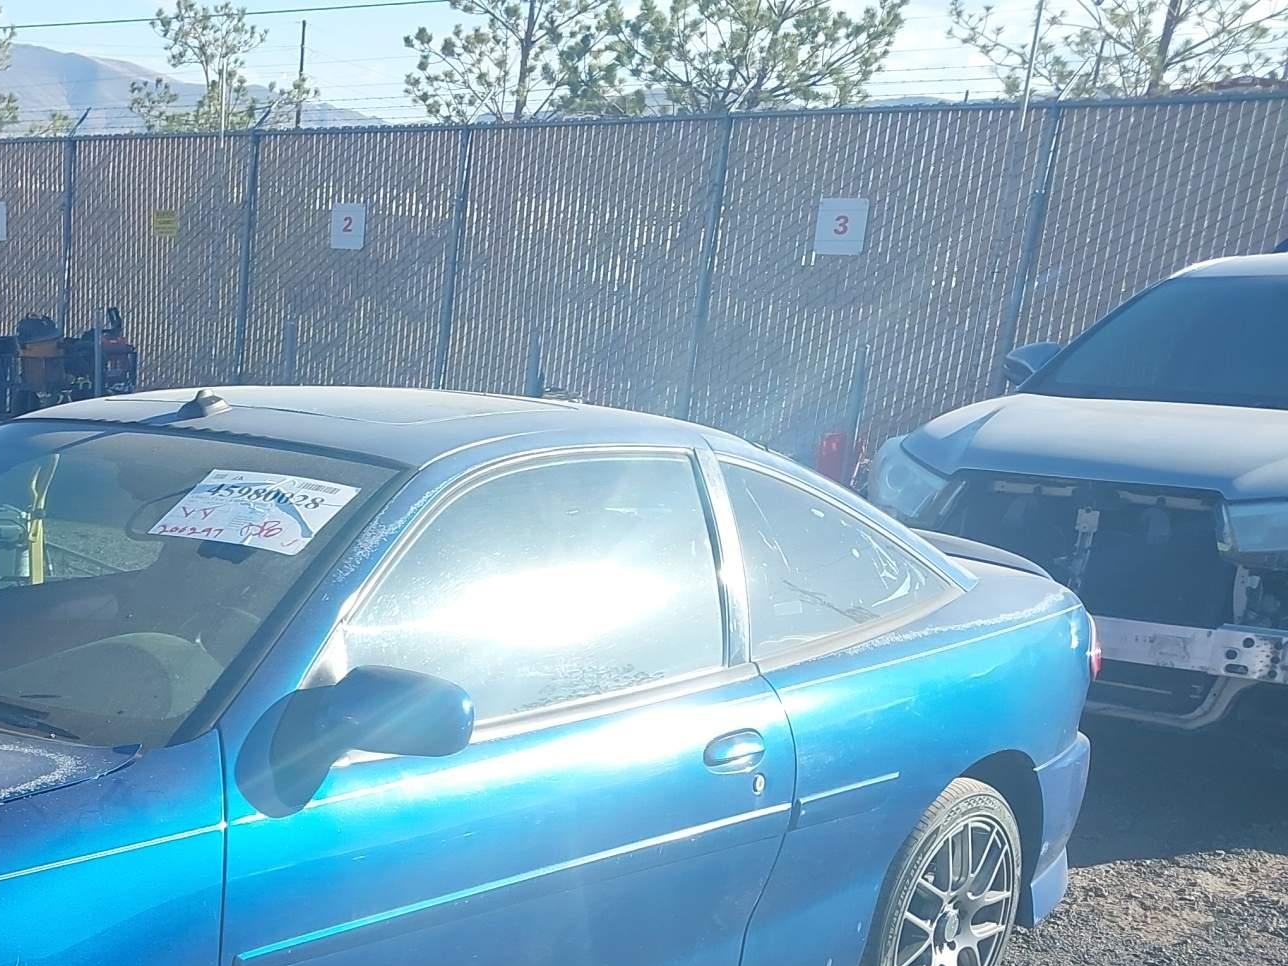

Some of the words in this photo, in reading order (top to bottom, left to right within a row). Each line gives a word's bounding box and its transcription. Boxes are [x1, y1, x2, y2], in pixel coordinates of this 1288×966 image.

[342, 216, 353, 232] 2
[833, 215, 849, 235] 3
[208, 483, 324, 510] 45980028
